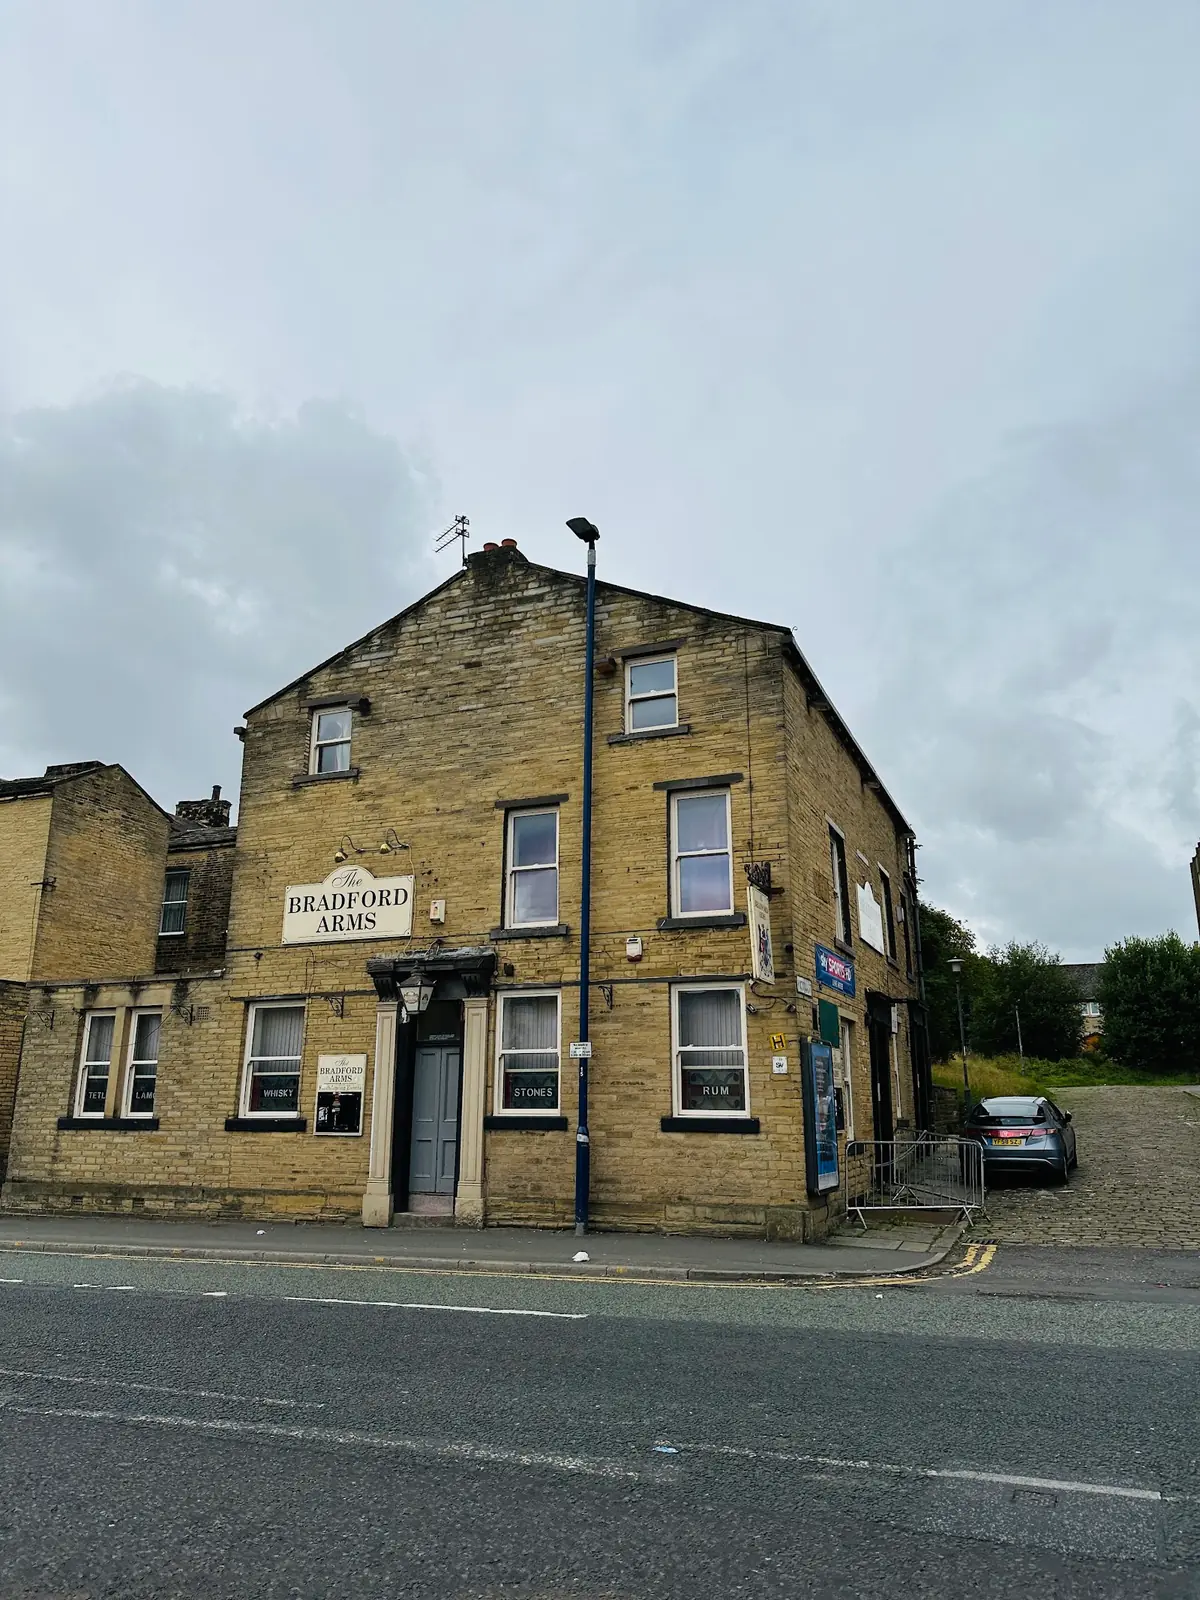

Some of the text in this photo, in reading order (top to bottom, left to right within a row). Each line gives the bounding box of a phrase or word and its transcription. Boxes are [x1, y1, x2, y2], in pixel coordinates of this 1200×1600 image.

[332, 869, 363, 888] The
[287, 888, 408, 914] BRADFORD
[316, 912, 376, 934] ARMS
[772, 1034, 785, 1049] H
[319, 1067, 363, 1075] BRADFORD
[88, 1091, 107, 1099] TETL
[263, 1089, 294, 1098] WHISKY
[514, 1088, 553, 1097] STONES
[703, 1086, 729, 1096] RUM
